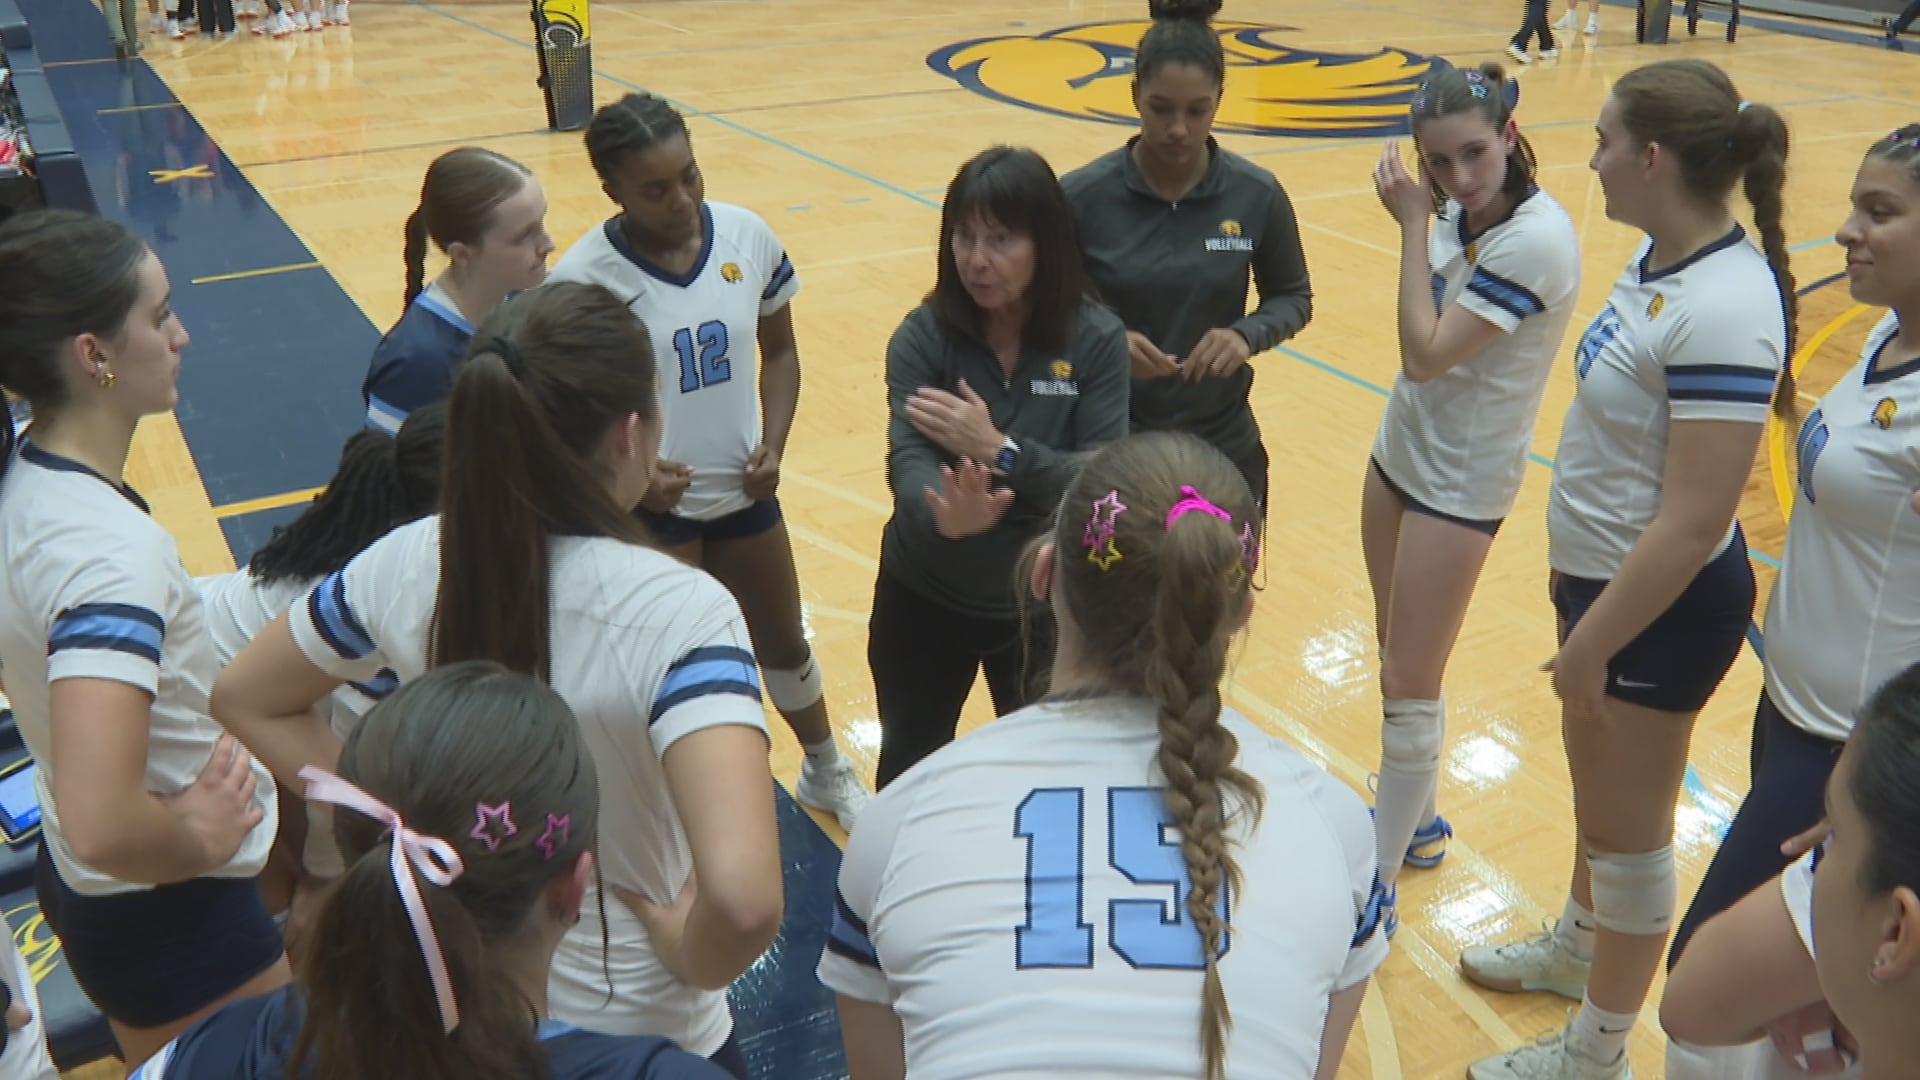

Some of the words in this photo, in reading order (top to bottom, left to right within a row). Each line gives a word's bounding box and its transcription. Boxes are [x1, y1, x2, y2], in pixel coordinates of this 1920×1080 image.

[1204, 237, 1254, 251] VOLLEYBALL
[672, 319, 732, 394] 12
[1013, 787, 1232, 971] 15
